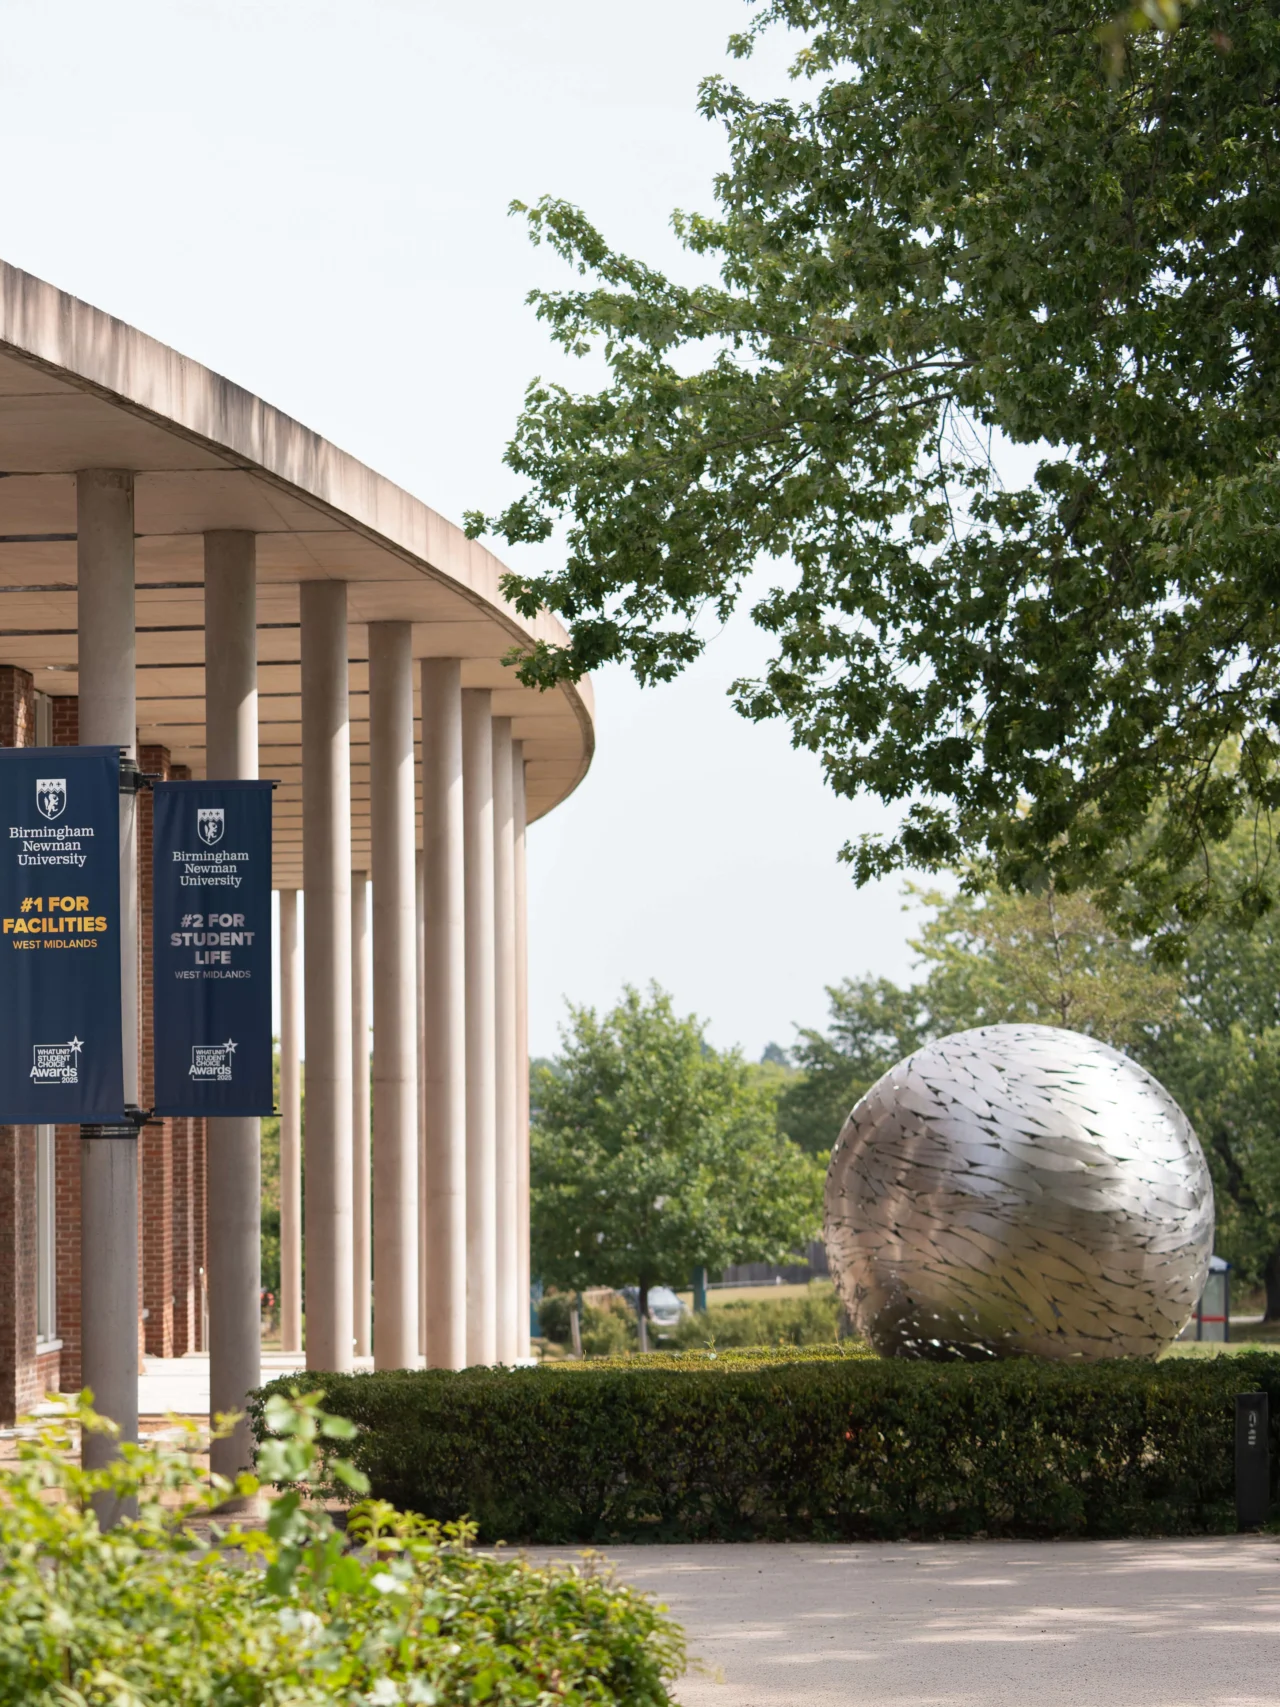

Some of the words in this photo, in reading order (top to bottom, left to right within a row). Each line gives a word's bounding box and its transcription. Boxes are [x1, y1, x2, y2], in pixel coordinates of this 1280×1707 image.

[9, 825, 94, 840] Birmingham
[23, 841, 81, 851] Newman
[18, 853, 86, 867] University
[173, 850, 249, 863] Birmingham
[185, 864, 237, 873] Newman
[180, 875, 242, 888] University
[21, 897, 42, 912] #1
[49, 896, 89, 911] FOR
[3, 917, 107, 933] FACILITIES
[181, 914, 203, 927] #2
[209, 914, 244, 927] FOR
[13, 940, 41, 949] WEST
[44, 939, 97, 948] MIDLANDS
[171, 932, 254, 946] STUDENT
[196, 951, 230, 964] LIFE
[30, 1066, 77, 1077] Awards
